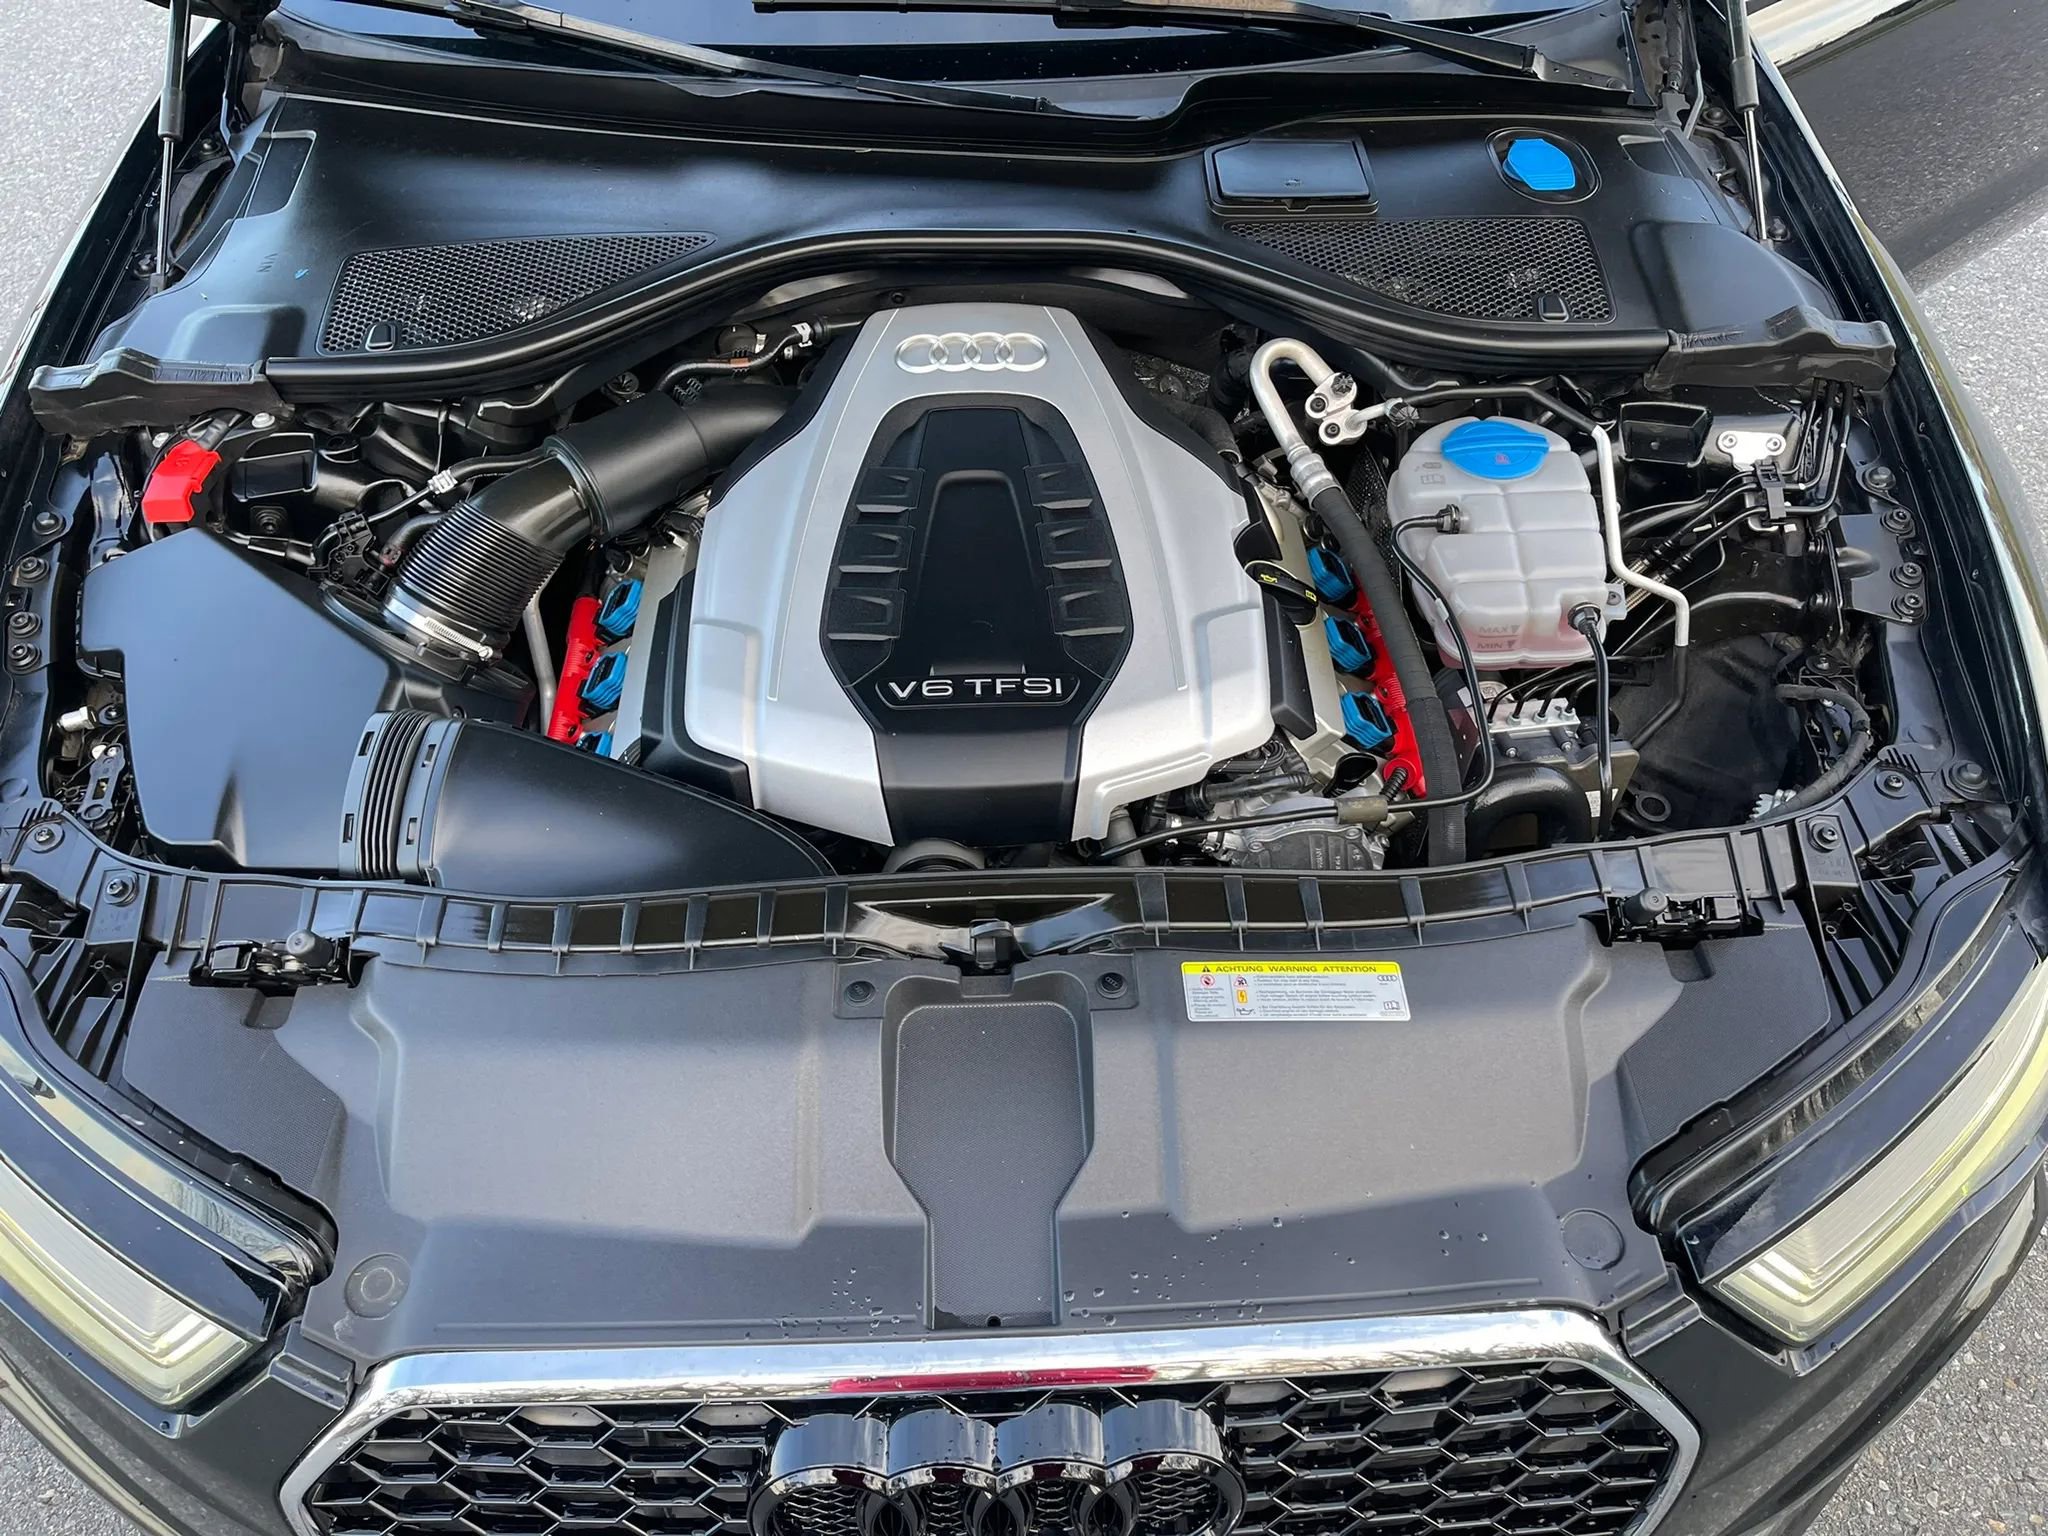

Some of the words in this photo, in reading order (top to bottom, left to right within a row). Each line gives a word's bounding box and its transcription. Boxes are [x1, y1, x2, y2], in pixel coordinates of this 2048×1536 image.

[1478, 625, 1509, 633] MAX
[888, 679, 953, 698] V6
[964, 677, 1062, 697] TFSI
